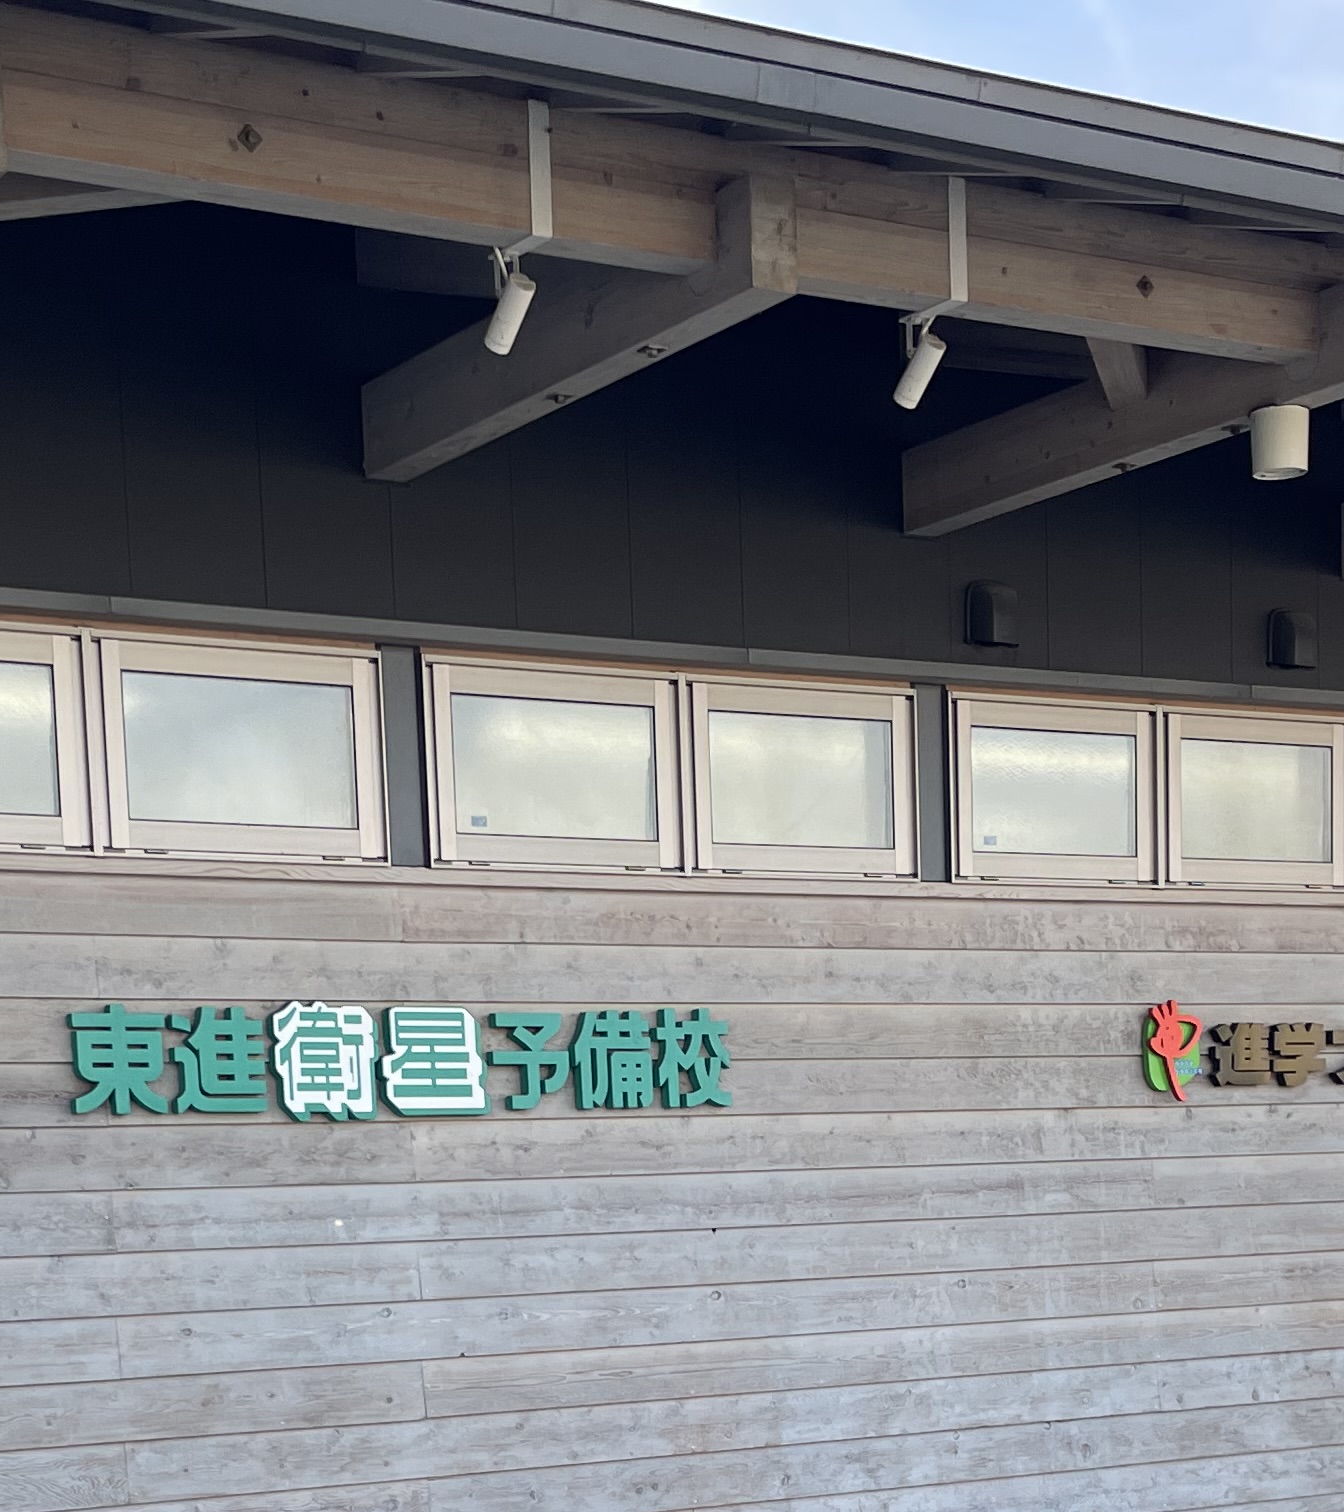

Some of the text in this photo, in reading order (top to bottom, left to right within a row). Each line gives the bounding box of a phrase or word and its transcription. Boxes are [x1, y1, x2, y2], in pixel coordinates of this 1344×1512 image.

[66, 1001, 733, 1122] 東進衛星予備校
